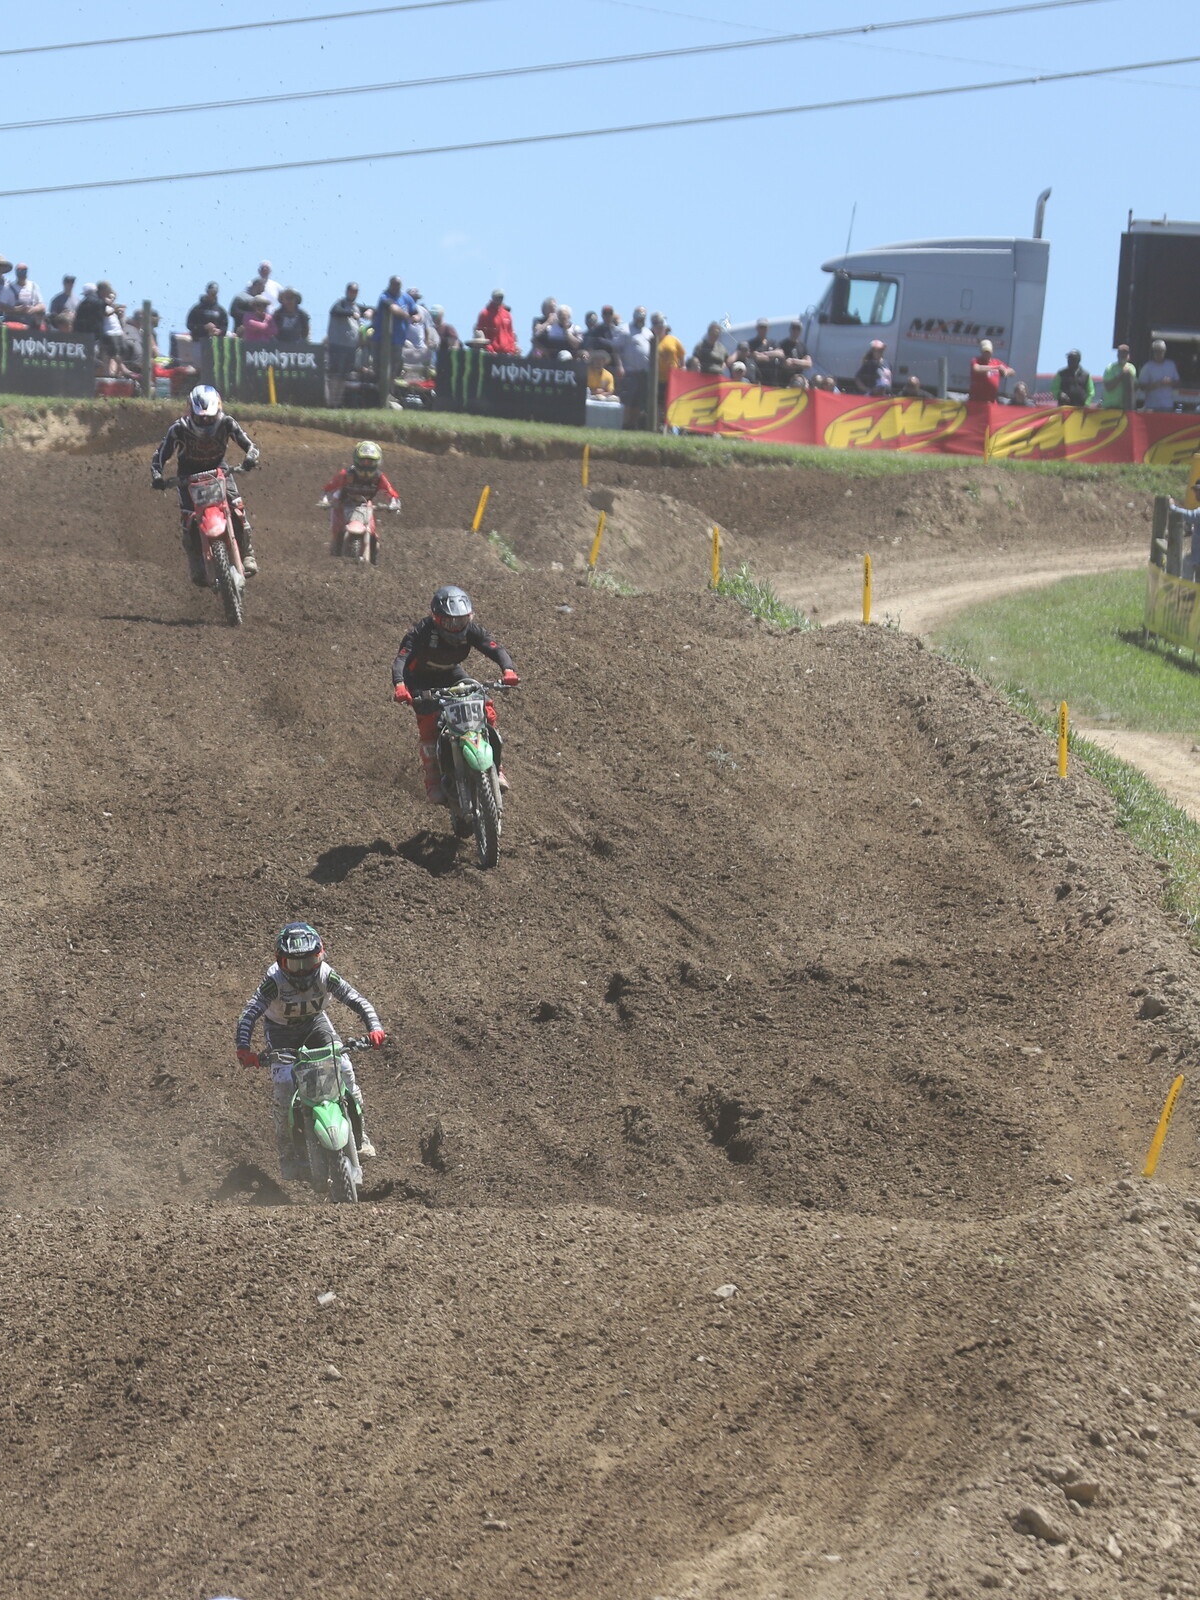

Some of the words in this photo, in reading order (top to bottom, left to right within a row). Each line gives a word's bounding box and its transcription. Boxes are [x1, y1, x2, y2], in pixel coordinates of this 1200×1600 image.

[12, 337, 87, 359] MONSTER
[245, 348, 317, 368] MONSTER
[256, 369, 307, 378] EERGY
[491, 363, 577, 386] MONSTER
[670, 386, 804, 427] FMF
[827, 400, 964, 449] FMF
[449, 702, 482, 724] 309
